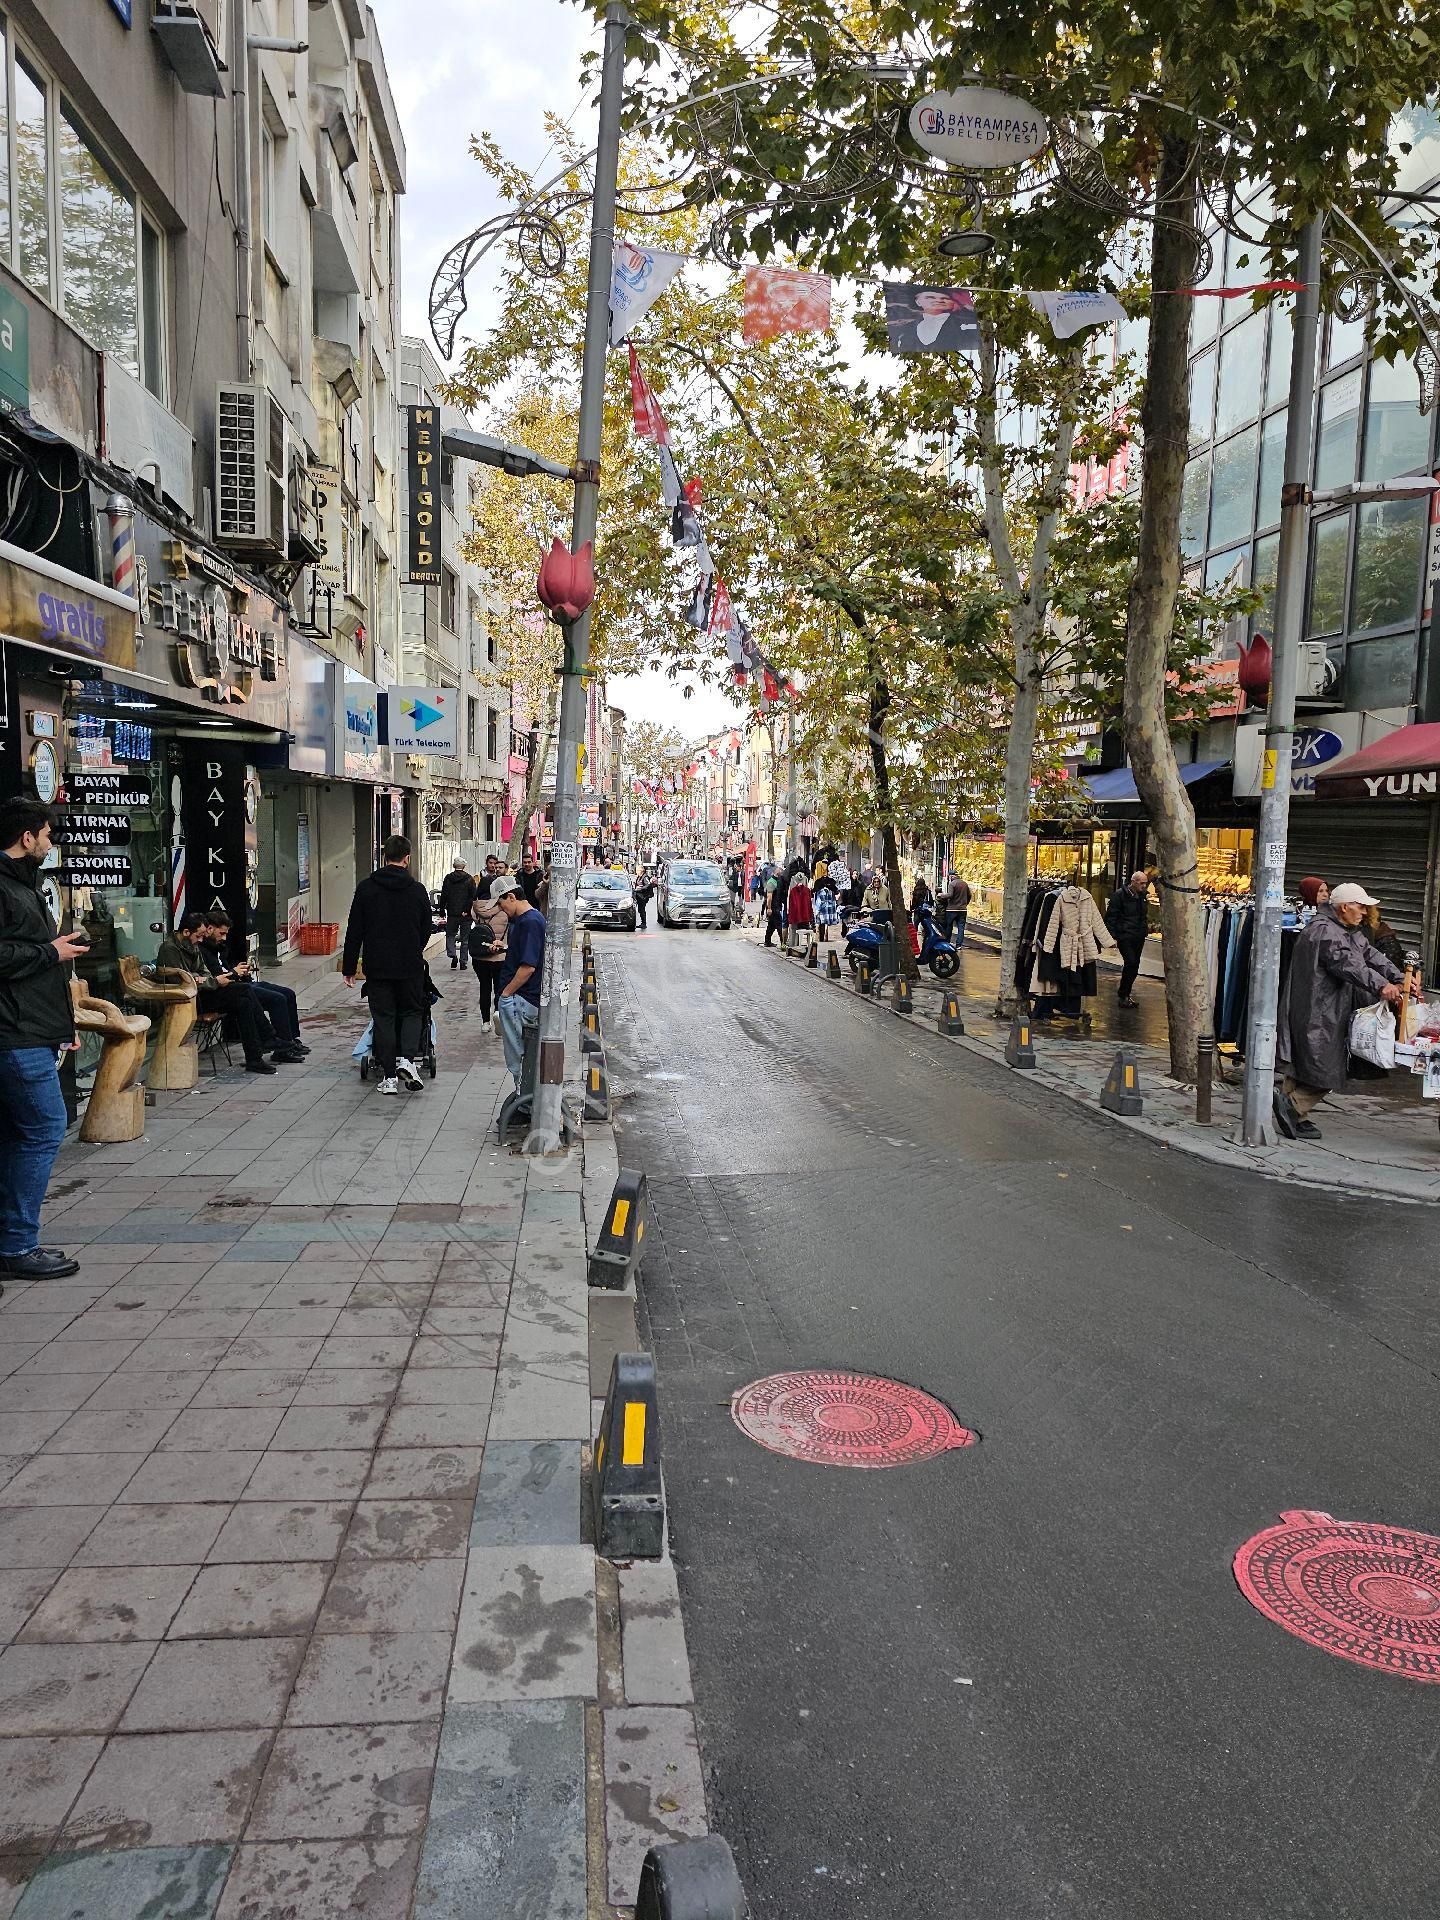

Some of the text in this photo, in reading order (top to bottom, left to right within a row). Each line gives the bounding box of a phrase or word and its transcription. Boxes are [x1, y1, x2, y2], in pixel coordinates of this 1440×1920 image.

[410, 571, 441, 581] BEAUTY
[38, 591, 107, 649] gratis
[394, 737, 451, 748] Türk Telekom
[74, 775, 120, 788] BAYAN
[85, 791, 150, 806] PEDİKÜR
[206, 761, 226, 827] BAY
[73, 815, 129, 828] TIRNAK
[67, 858, 131, 869] ESYONEL
[71, 873, 123, 885] BAKIMI
[208, 847, 227, 912] KUA
